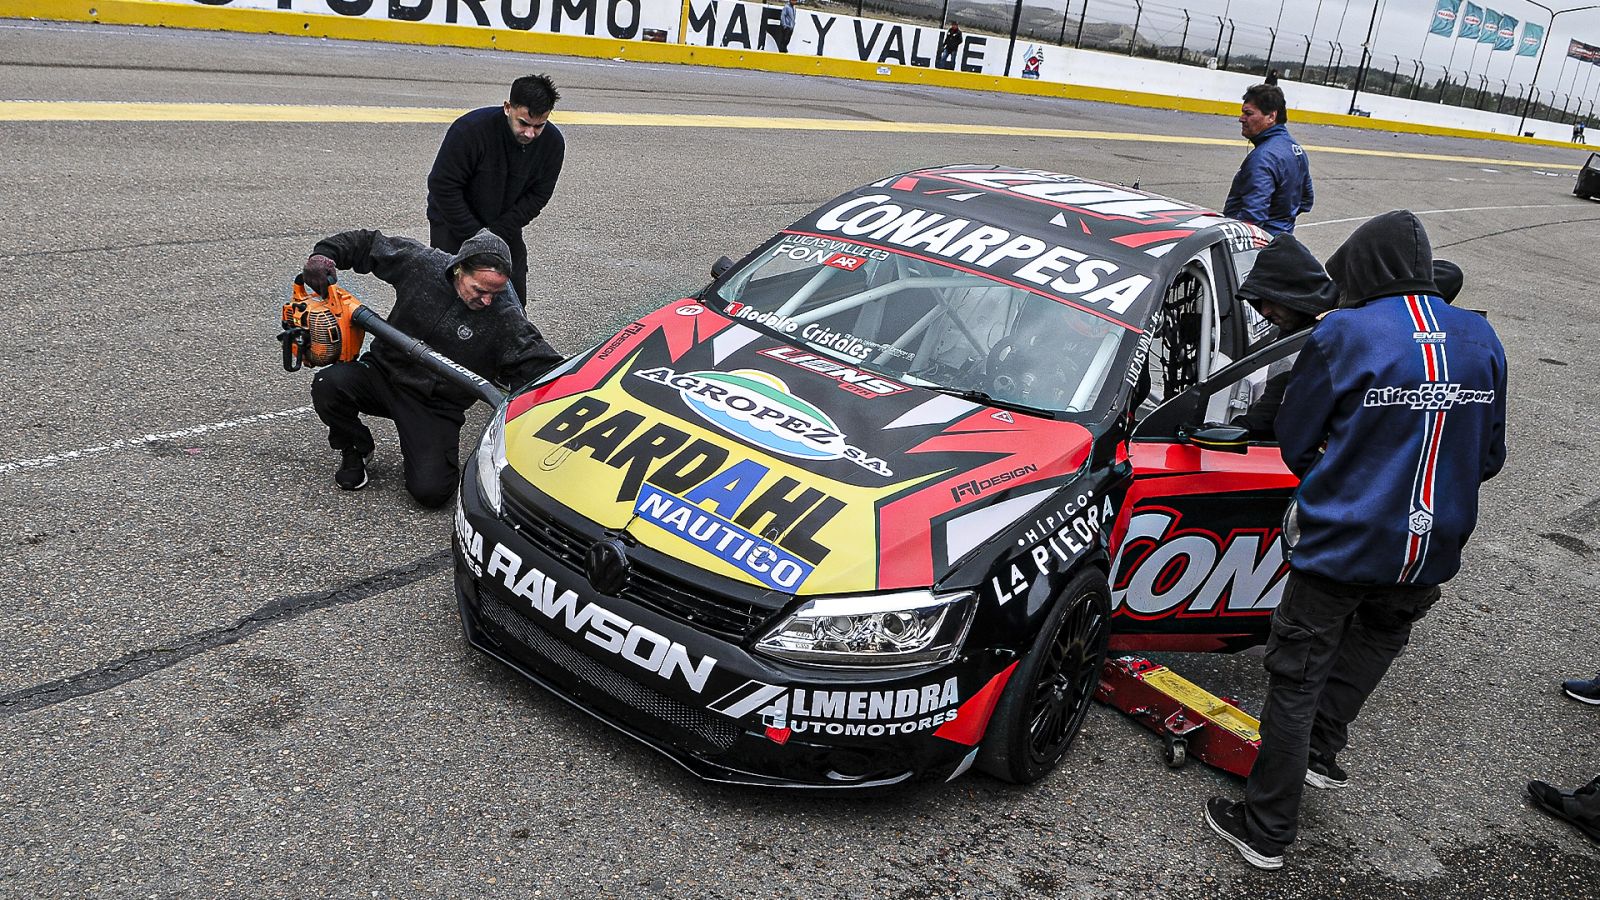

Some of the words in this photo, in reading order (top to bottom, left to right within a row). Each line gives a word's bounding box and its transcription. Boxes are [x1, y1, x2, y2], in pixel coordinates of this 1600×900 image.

[811, 14, 837, 56] Y
[772, 243, 832, 264] FON
[831, 255, 858, 269] AR
[815, 193, 1154, 316] CONARPESA
[597, 333, 630, 361] DESIGN
[736, 305, 799, 333] Rodolfo
[802, 323, 873, 360] Cristales
[763, 347, 905, 394] LIONS
[634, 366, 844, 447] AGROPEZ
[844, 447, 894, 477] S.A.
[534, 395, 849, 566] BARDAHL
[979, 463, 1039, 491] DESIGN
[638, 492, 804, 589] NAUTICO
[992, 563, 1029, 607] LA
[1031, 494, 1115, 576] PIEDRA
[487, 541, 718, 694] RAWSON
